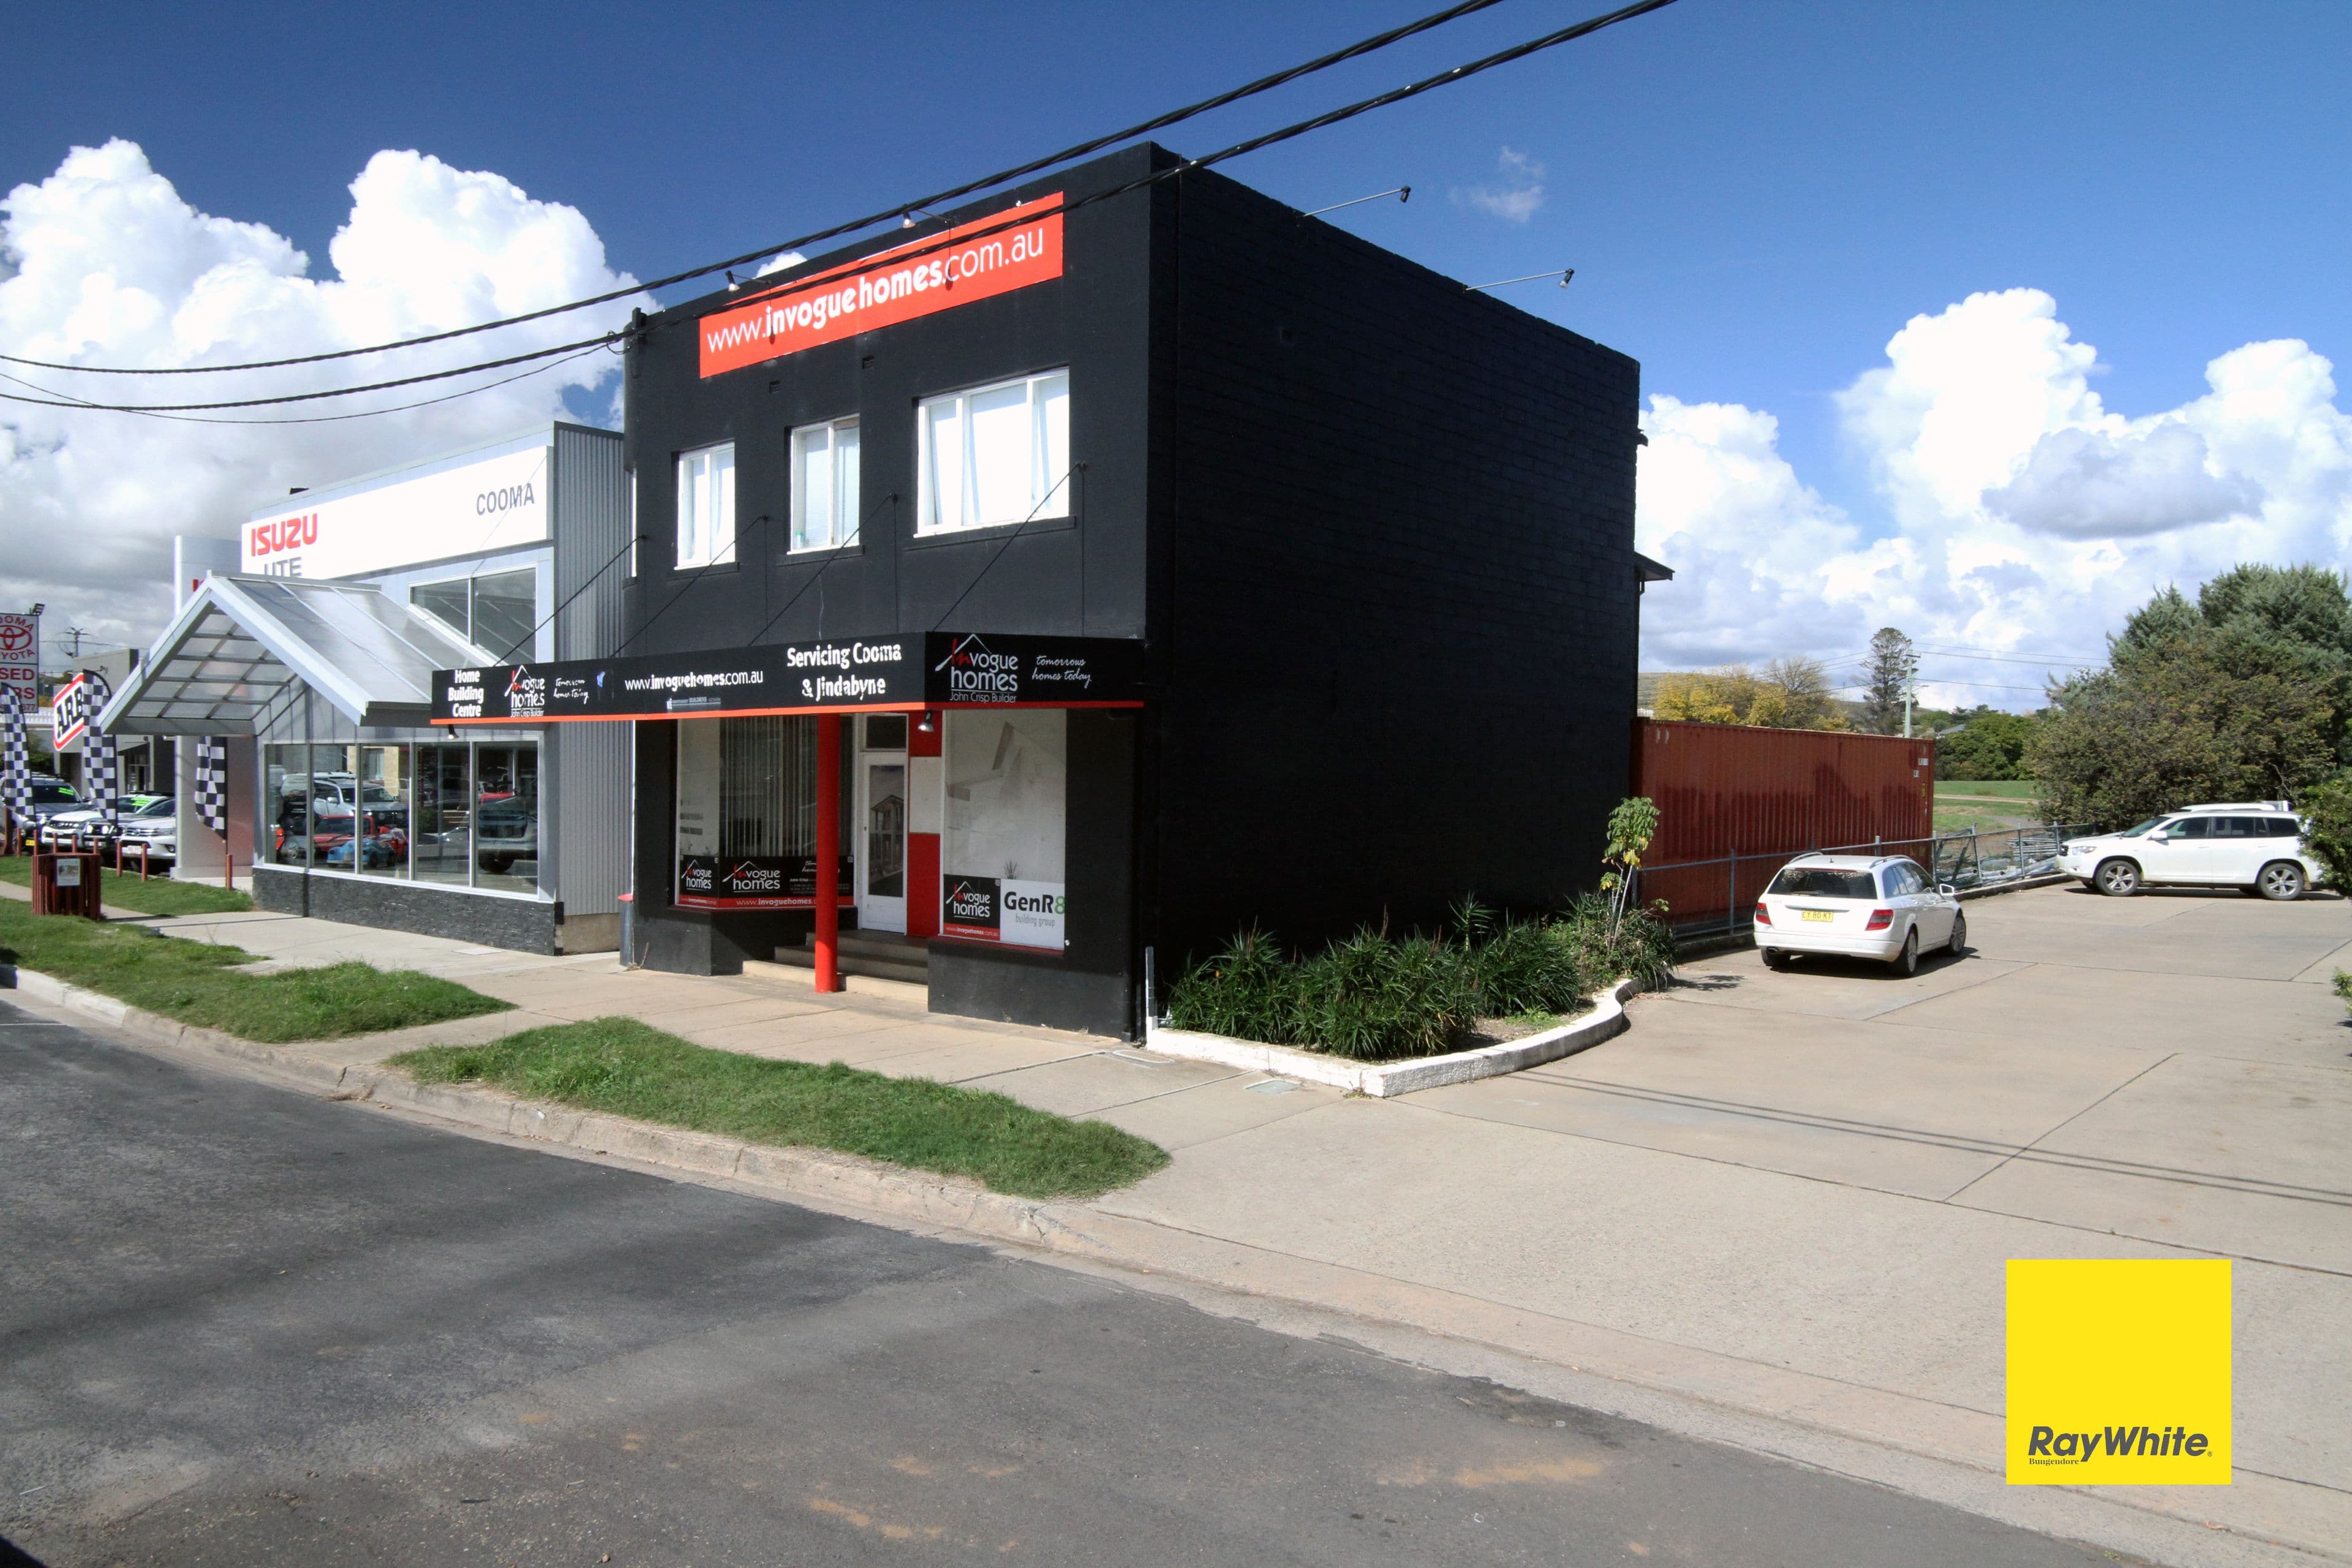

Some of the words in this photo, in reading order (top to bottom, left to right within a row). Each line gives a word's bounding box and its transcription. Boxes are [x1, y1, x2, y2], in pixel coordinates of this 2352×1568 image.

[707, 228, 1044, 354] www.invoguehomes.com.au
[476, 482, 535, 516] COOMA
[251, 513, 318, 557] ISUZU
[787, 644, 851, 669] Servicing
[853, 642, 902, 664] Cooma
[454, 669, 481, 684] Home
[625, 671, 763, 692] www.invoguehomes.com.au
[951, 666, 1019, 692] homes
[1031, 667, 1062, 681] homes
[1064, 670, 1093, 689] today
[448, 686, 484, 704] Building
[802, 679, 813, 698] &
[815, 674, 886, 702] Jindabyne
[949, 692, 968, 701] John
[970, 692, 990, 704] Crisp
[992, 692, 1017, 703] Builder
[511, 691, 545, 707] homes
[56, 686, 84, 739] ARB
[452, 702, 481, 718] Centre
[685, 875, 712, 889] homes
[732, 878, 781, 891] homes
[953, 901, 990, 918] homes
[1004, 891, 1065, 914] GenR8
[1016, 913, 1037, 927] building
[1038, 918, 1055, 929] group
